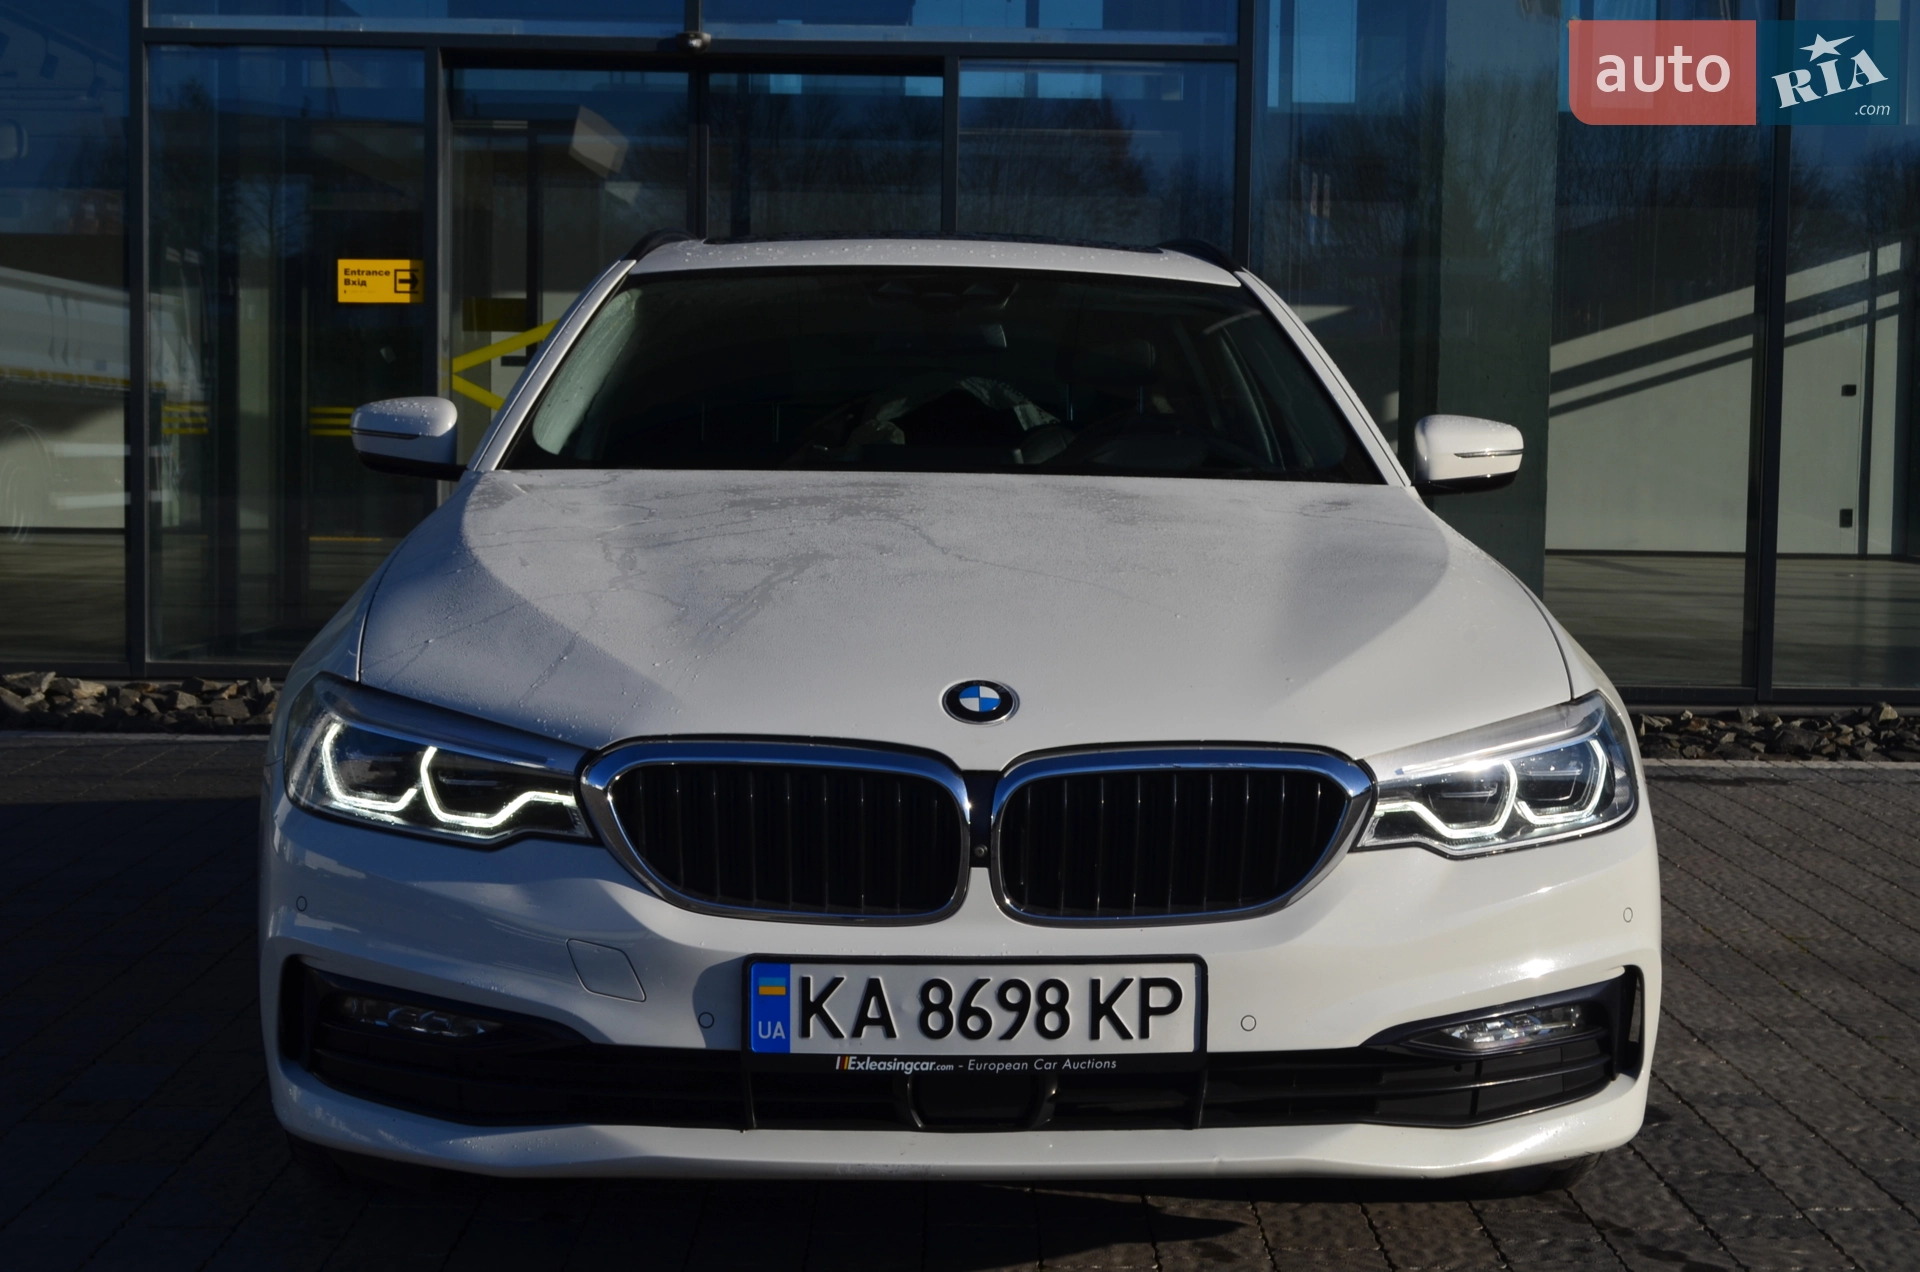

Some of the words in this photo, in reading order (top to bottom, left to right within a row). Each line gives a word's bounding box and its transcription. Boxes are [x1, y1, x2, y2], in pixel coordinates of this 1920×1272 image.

[343, 267, 391, 277] Entrance
[343, 278, 367, 287] Вхід
[800, 976, 897, 1039] KA
[918, 977, 1071, 1041] 8698
[1090, 977, 1184, 1041] KP
[758, 1021, 786, 1040] UA
[847, 1055, 954, 1075] Exleasingcar.com
[967, 1058, 1029, 1074] European
[1033, 1058, 1058, 1070] Car
[1061, 1057, 1118, 1070] Auctions
